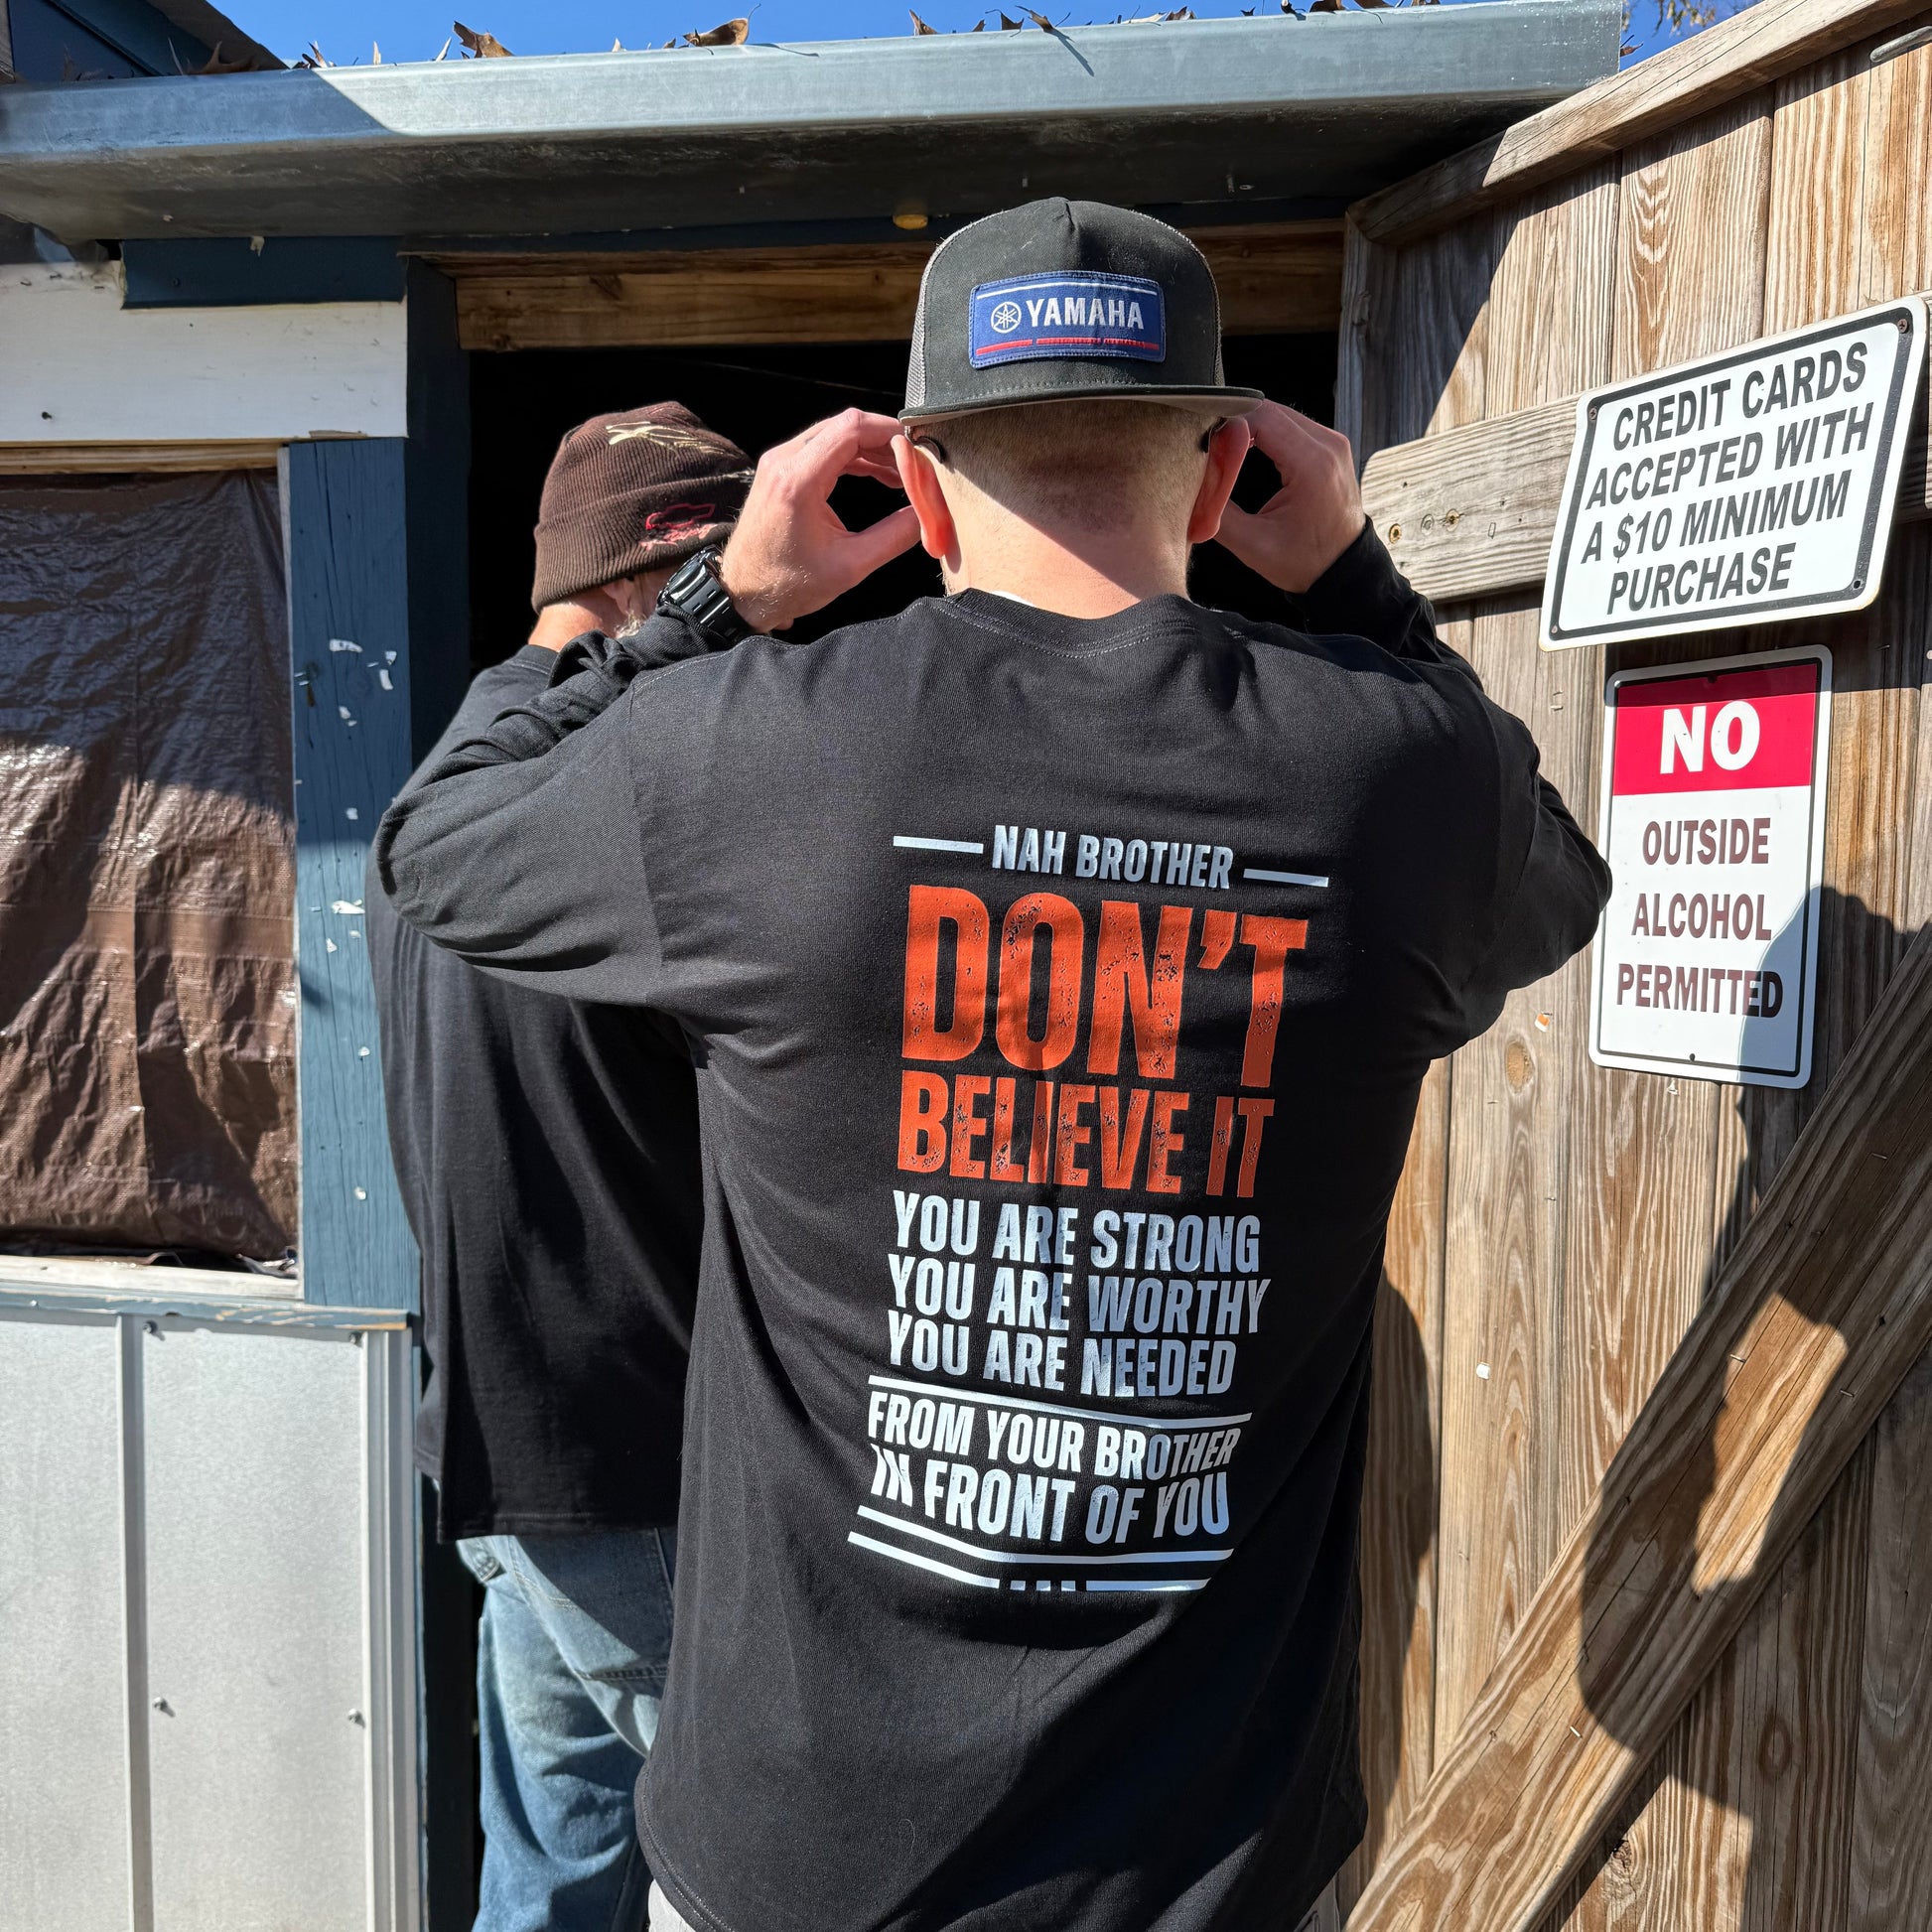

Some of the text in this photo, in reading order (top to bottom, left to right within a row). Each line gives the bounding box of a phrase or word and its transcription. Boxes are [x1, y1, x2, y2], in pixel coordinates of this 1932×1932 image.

[1027, 297, 1144, 330] YAMAHA
[1613, 341, 1868, 452] CREDIT CARDS
[1586, 401, 1874, 510] ACCEPTED WITH
[1581, 469, 1853, 564] A $10 MINIMUM
[1607, 542, 1796, 616] PURCHASE
[1660, 700, 1760, 774] NO
[992, 824, 1235, 890] NAH BROTHER
[1642, 817, 1771, 865] OUTSIDE
[1631, 893, 1772, 940] ALCOHOL
[901, 884, 1309, 1088] DON'T
[1616, 963, 1783, 1019] PERMITTED
[897, 1069, 1276, 1197] BELIEVE IT
[893, 1189, 1262, 1274] YOU ARE STRONG
[888, 1253, 1272, 1335] YOU ARE WORTHY
[888, 1310, 1237, 1398] YOU ARE NEEDED
[868, 1391, 1242, 1481] FROM YOUR BROTHER
[870, 1443, 1230, 1545] IN FRONT OF YOU
